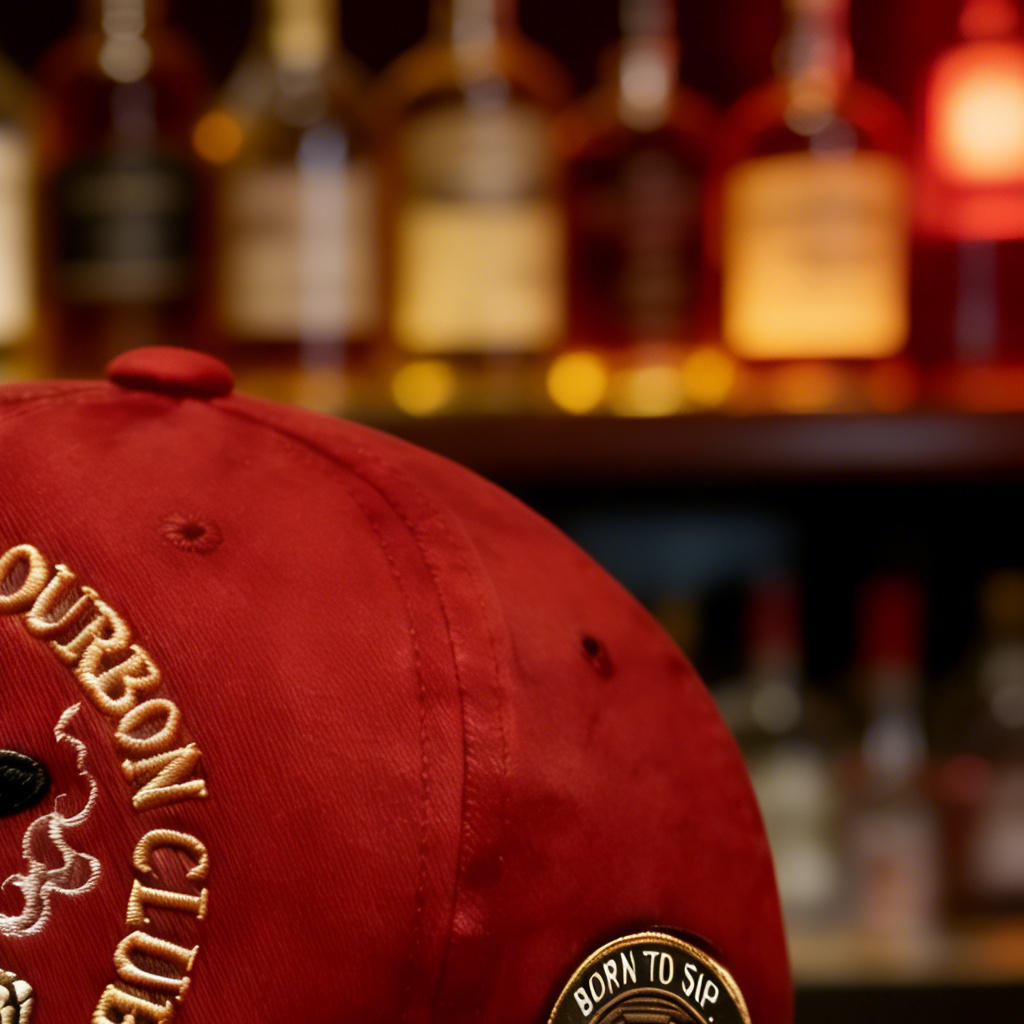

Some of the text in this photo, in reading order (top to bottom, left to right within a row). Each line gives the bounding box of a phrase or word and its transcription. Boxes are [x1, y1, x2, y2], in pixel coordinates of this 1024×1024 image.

[573, 950, 720, 1023] BORN TO SIP.
